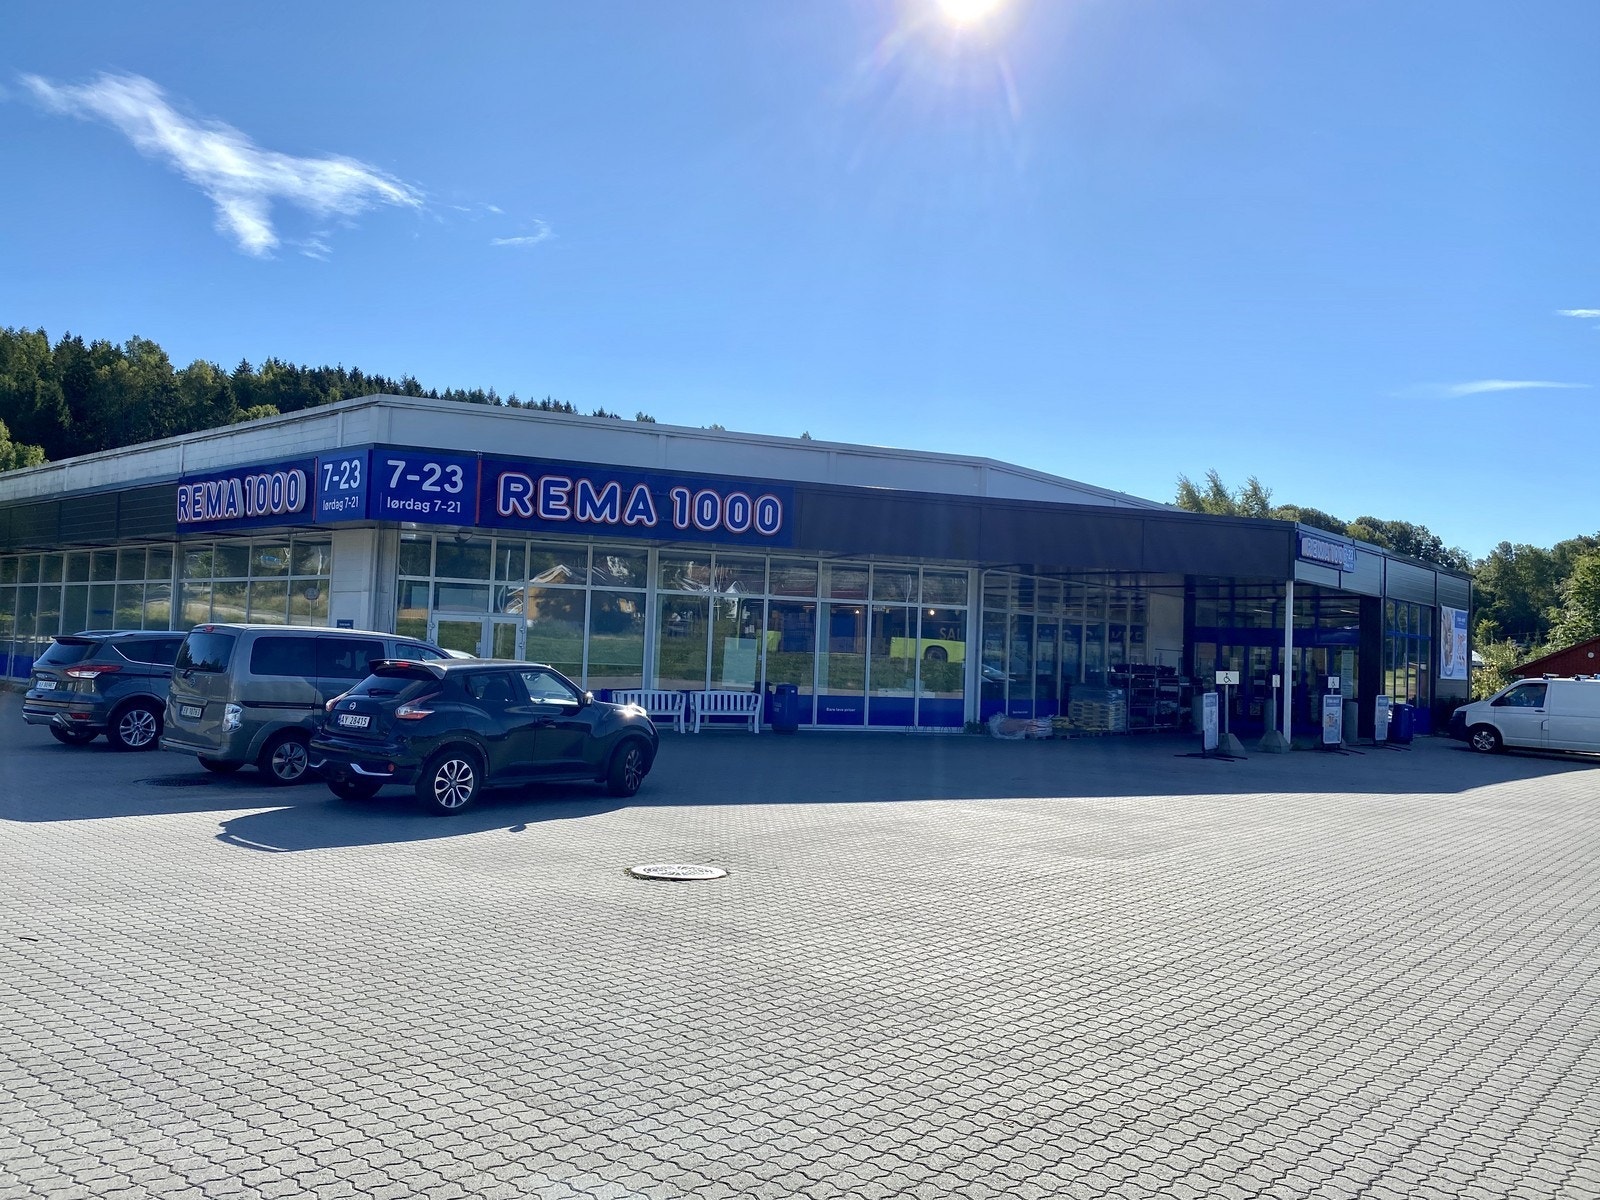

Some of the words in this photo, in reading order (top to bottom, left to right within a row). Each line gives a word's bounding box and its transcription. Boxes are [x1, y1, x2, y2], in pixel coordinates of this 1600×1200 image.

[324, 460, 360, 491] 7-23
[387, 460, 463, 493] 7-23
[178, 477, 243, 523] REMA
[245, 469, 305, 516] 1000
[323, 499, 343, 511] lørdag
[345, 496, 359, 508] 7-21
[387, 497, 430, 513] lørdag
[434, 500, 461, 513] 7-21
[497, 472, 658, 527] REMA
[670, 486, 783, 535] 1000
[341, 715, 349, 724] AY
[350, 716, 368, 726] 28415
